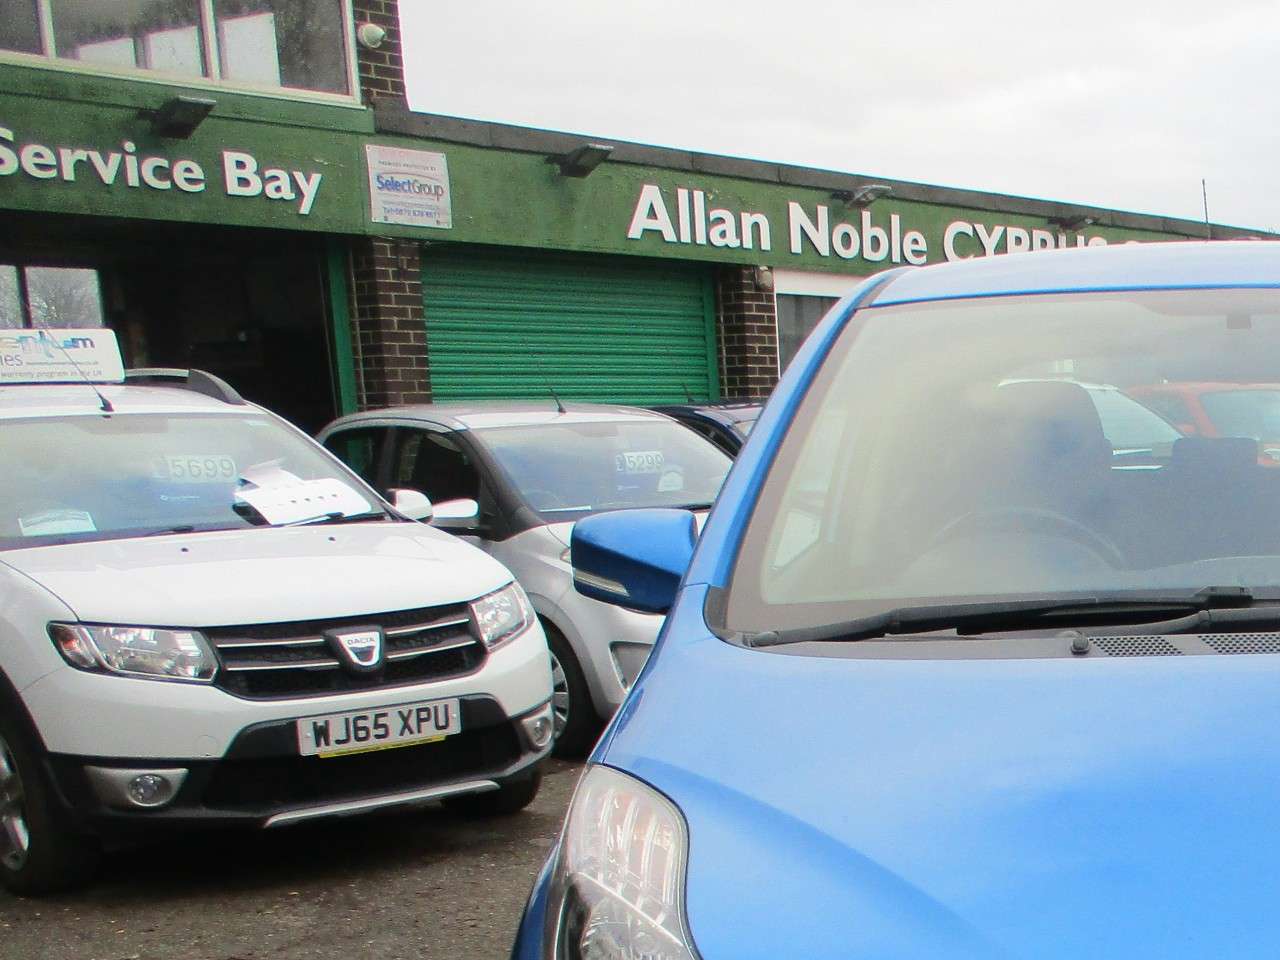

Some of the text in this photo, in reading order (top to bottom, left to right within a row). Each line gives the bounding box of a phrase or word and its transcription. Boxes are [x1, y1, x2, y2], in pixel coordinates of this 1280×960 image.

[0, 126, 322, 215] Service Bay
[627, 183, 1108, 266] Allan Noble CYPR
[171, 458, 234, 479] 5699
[347, 637, 376, 646] DACIA
[312, 704, 450, 748] WJ65 XPU
